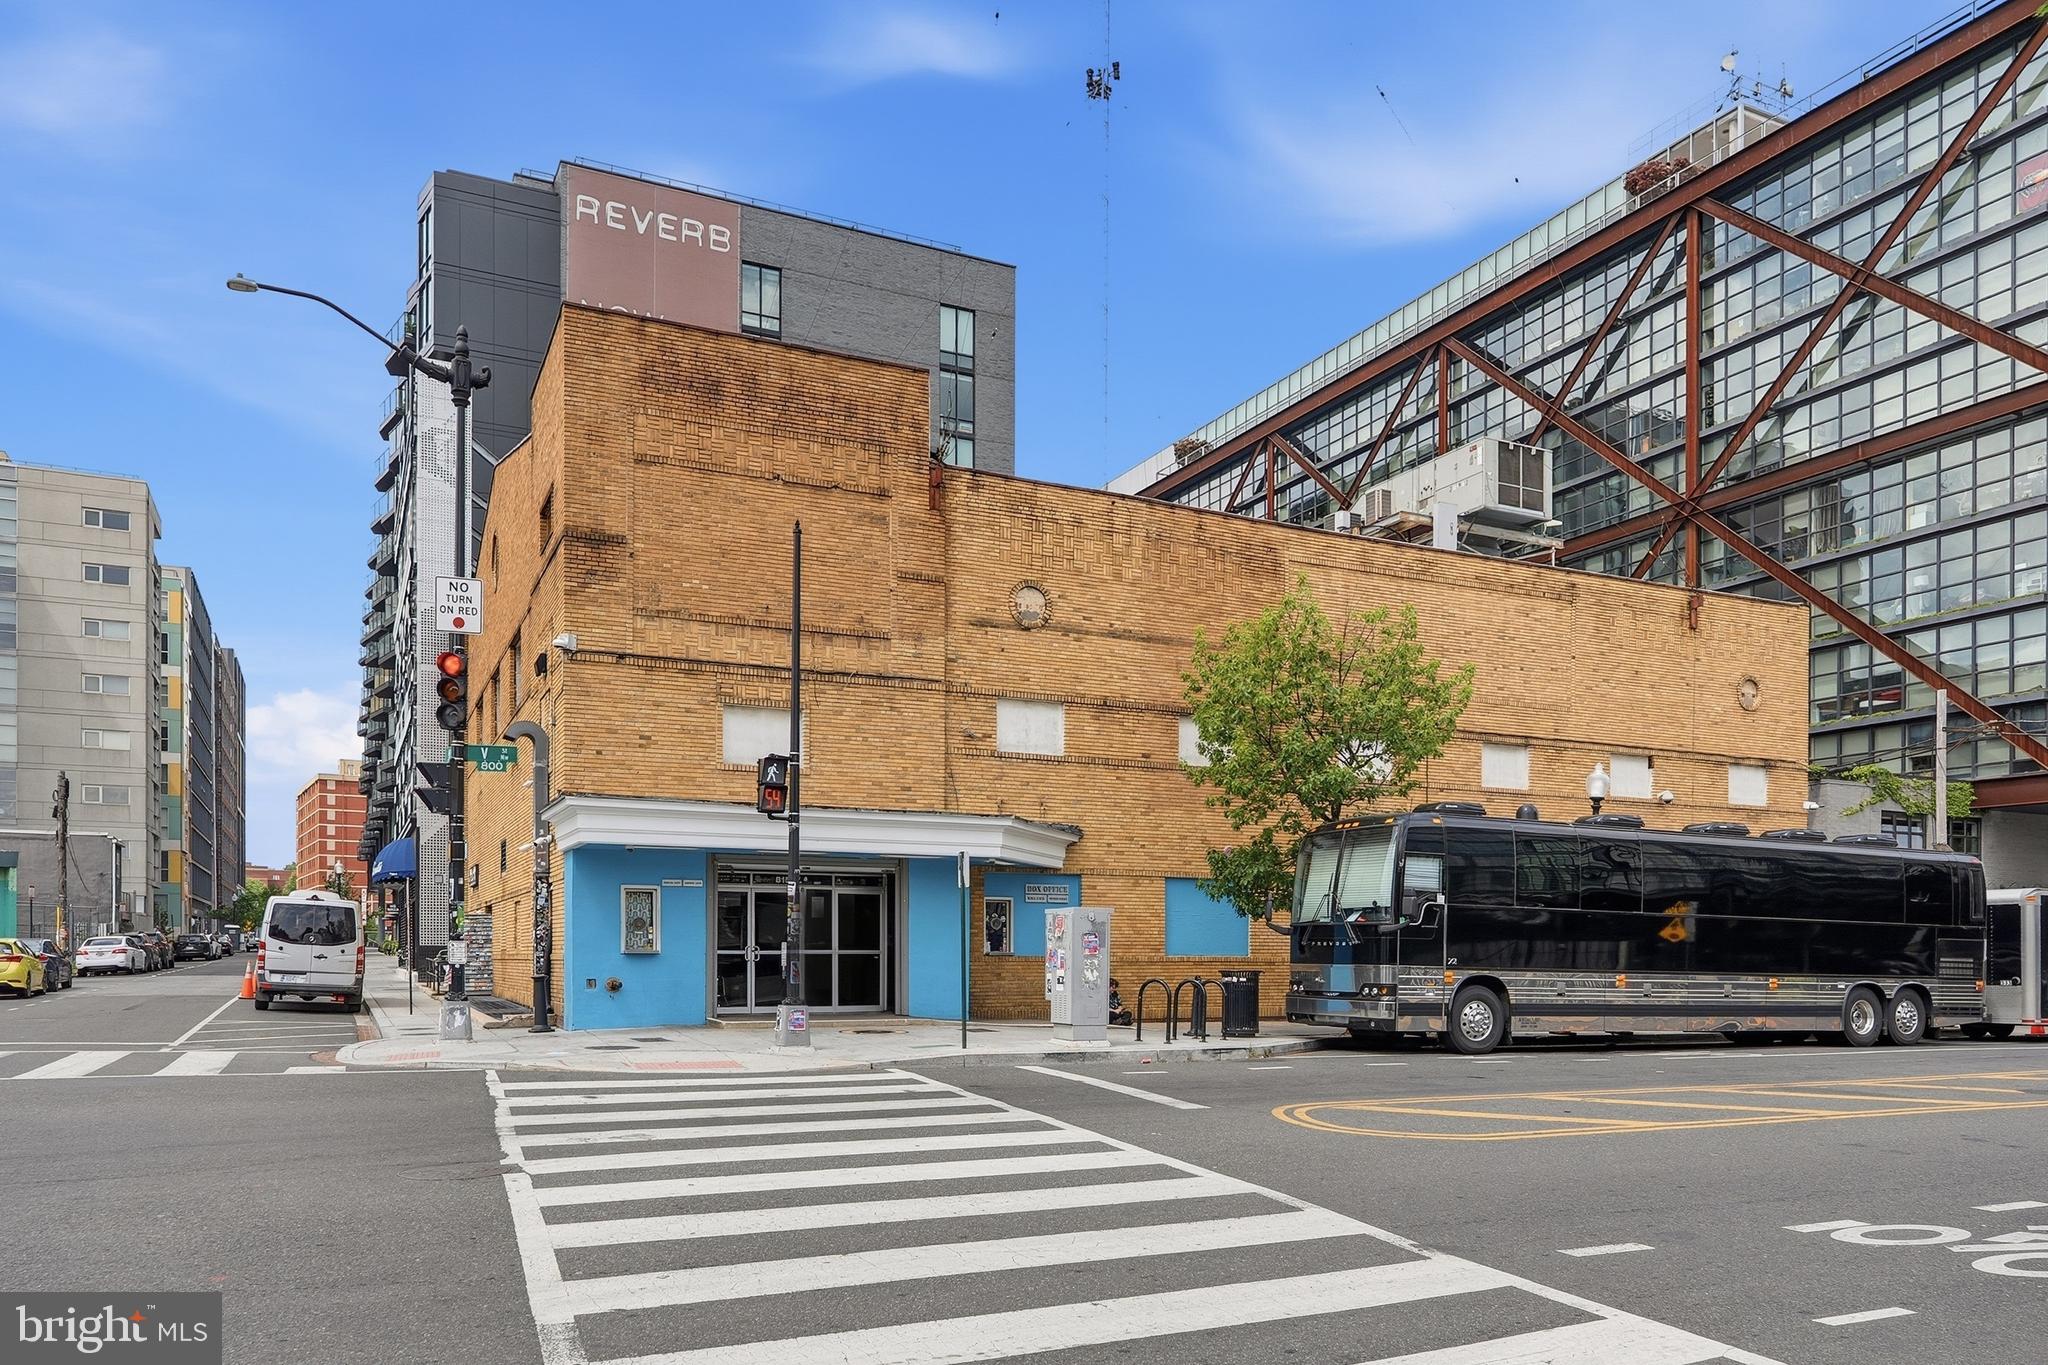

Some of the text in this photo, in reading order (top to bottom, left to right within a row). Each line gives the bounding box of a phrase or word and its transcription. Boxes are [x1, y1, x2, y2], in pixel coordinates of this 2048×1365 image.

[575, 194, 731, 253] REVERB
[449, 581, 469, 593] NO
[446, 593, 473, 604] TURN
[439, 604, 478, 616] ON RED
[480, 747, 489, 759] V
[480, 761, 503, 770] 800
